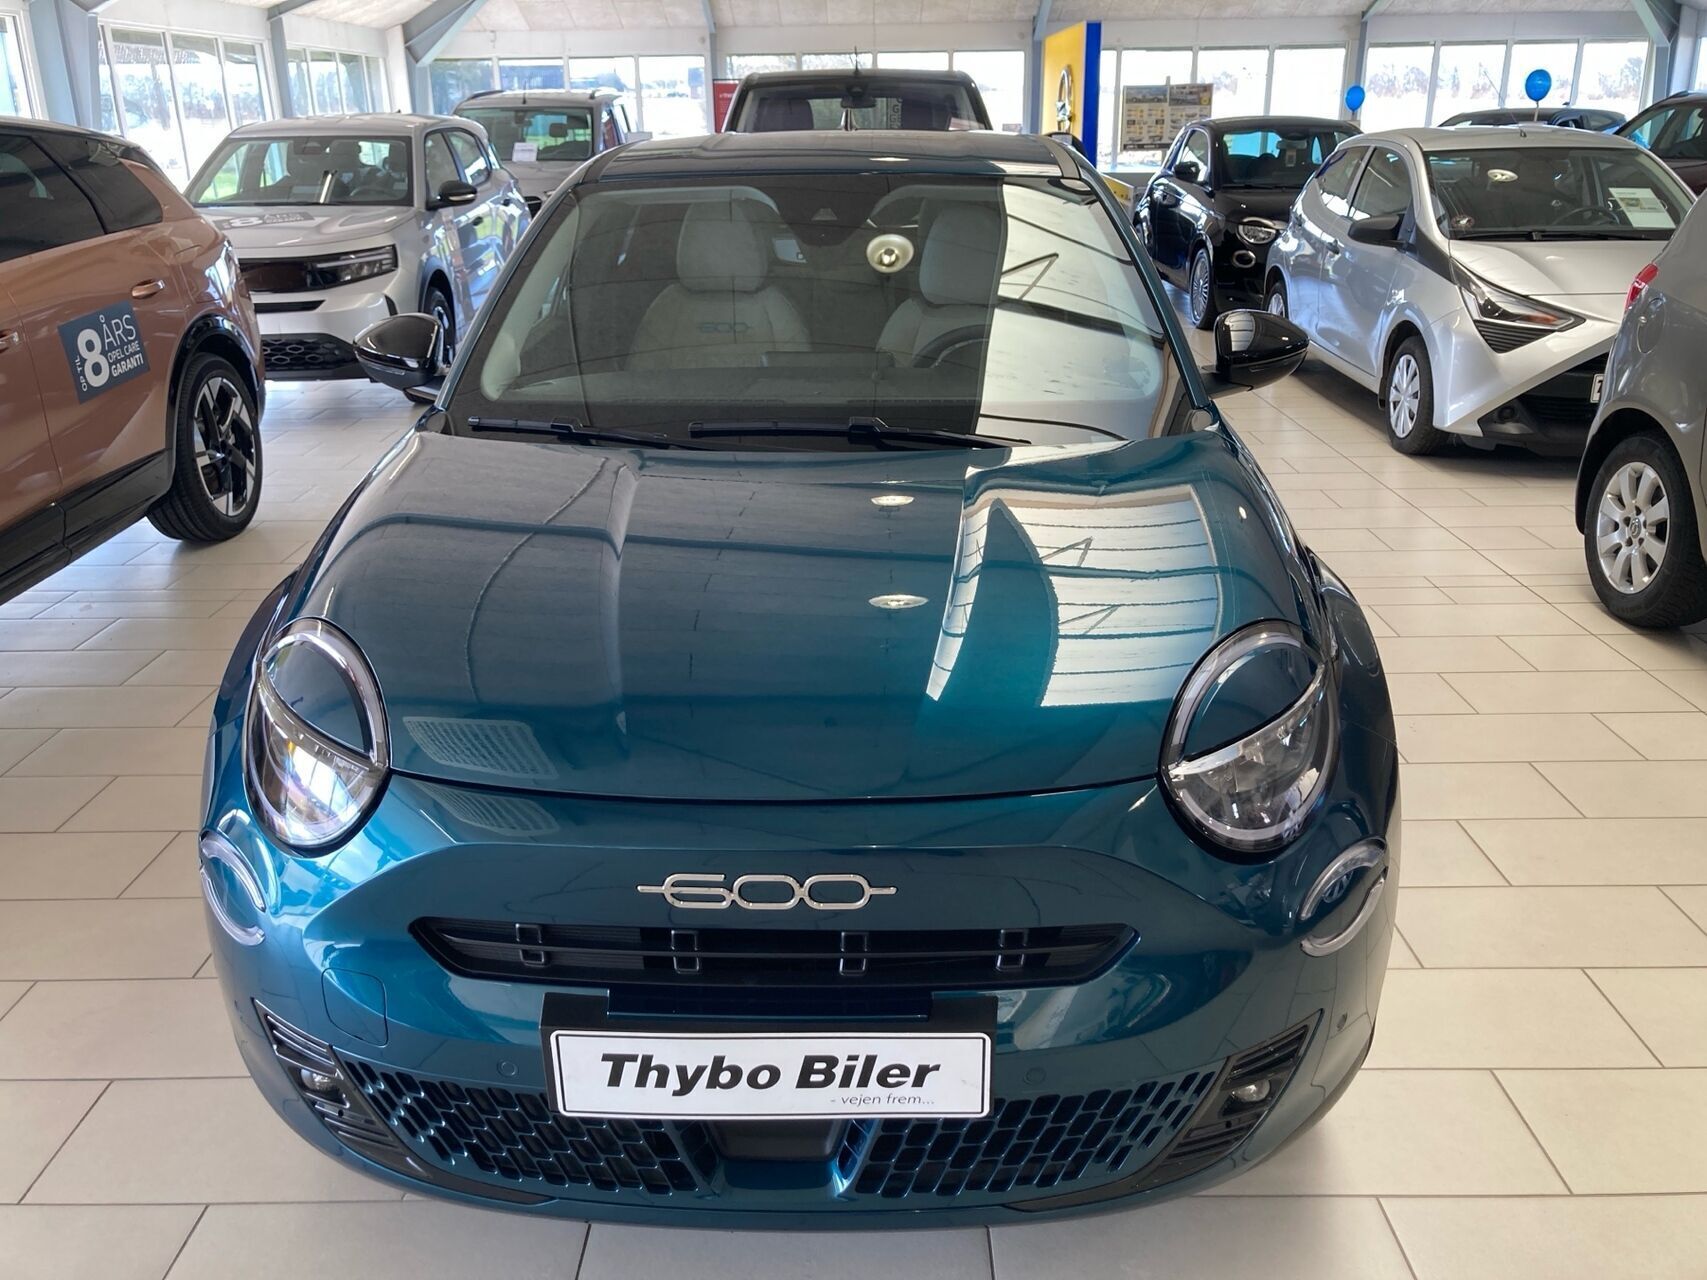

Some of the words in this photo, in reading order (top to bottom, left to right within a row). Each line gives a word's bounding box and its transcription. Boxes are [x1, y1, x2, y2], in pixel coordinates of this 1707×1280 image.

[77, 328, 110, 388] 8
[99, 314, 137, 351] ÅRS
[107, 348, 125, 363] OPEL
[123, 341, 141, 356] CARE
[111, 352, 144, 377] GARANTI
[637, 873, 898, 910] 600
[601, 1053, 782, 1097] Thybo
[795, 1054, 942, 1089] Biler
[841, 1094, 881, 1108] vejen
[886, 1092, 935, 1105] frem...
